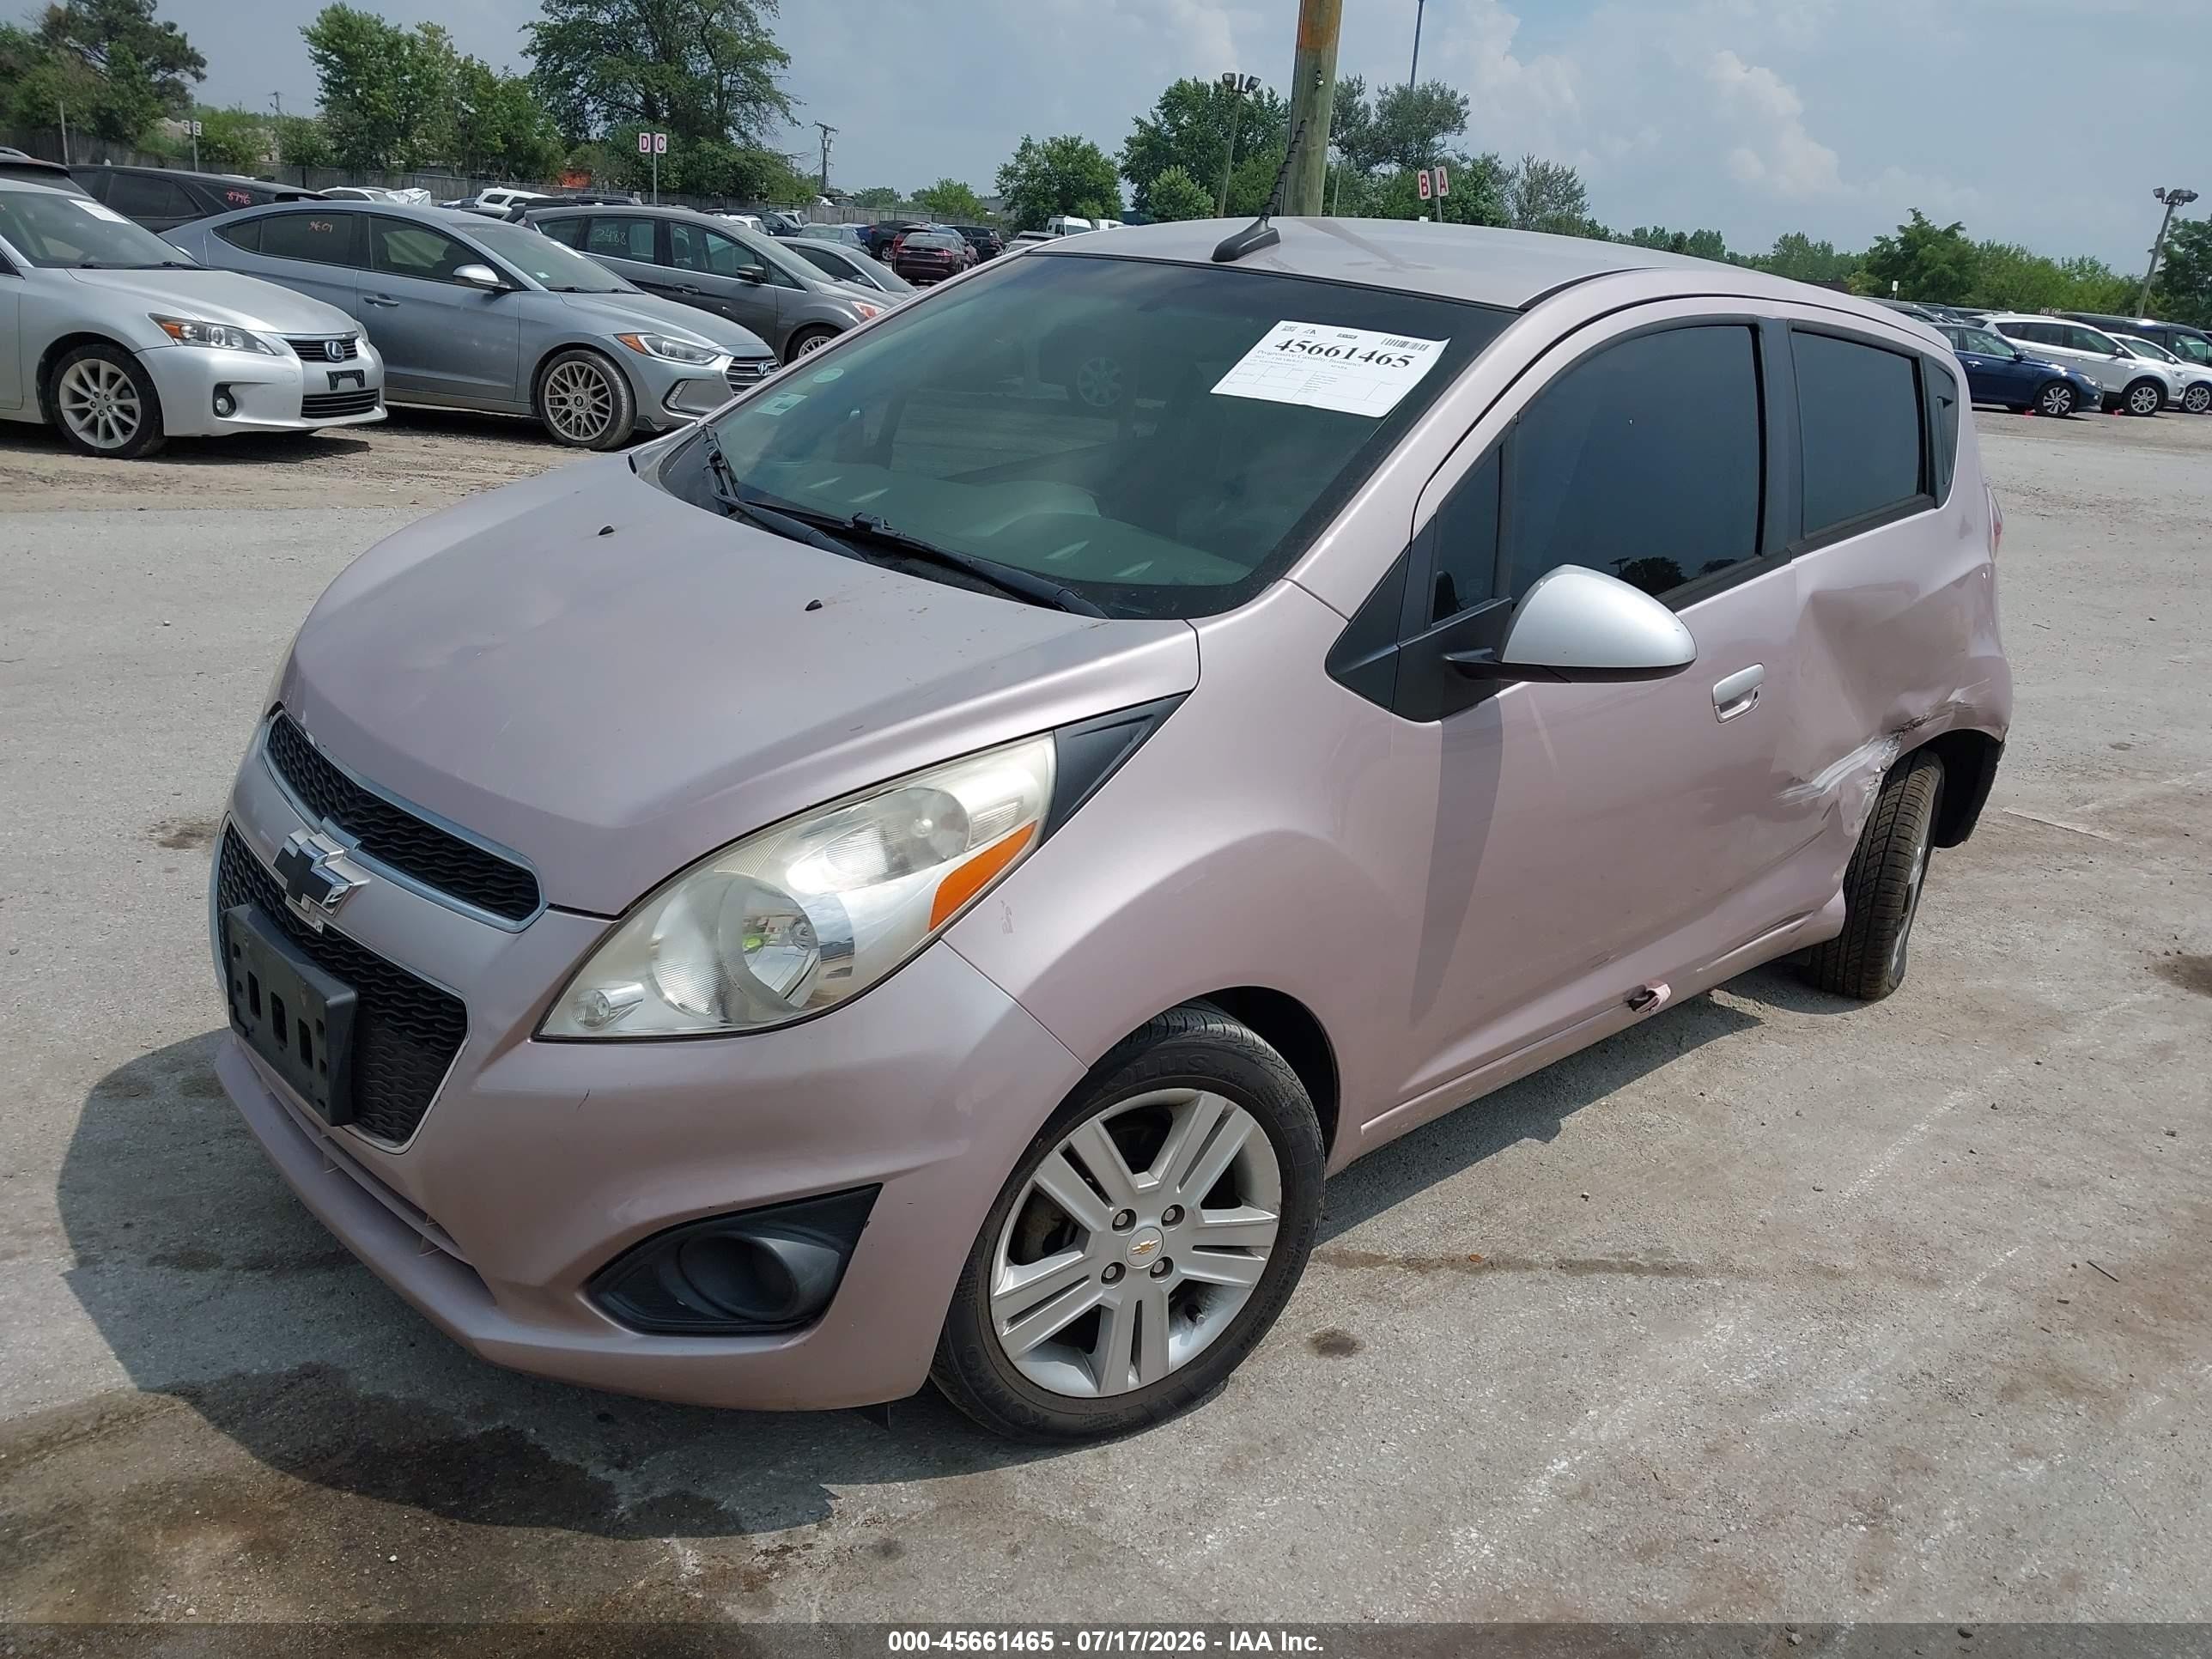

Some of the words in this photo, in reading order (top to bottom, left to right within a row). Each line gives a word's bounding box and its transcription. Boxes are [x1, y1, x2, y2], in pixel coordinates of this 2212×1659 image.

[641, 136, 648, 150] D
[657, 137, 665, 151] C
[1420, 174, 1429, 196] B
[1439, 171, 1447, 194] A
[1274, 338, 1416, 368] 45661465
[1328, 358, 1363, 368] Insurance
